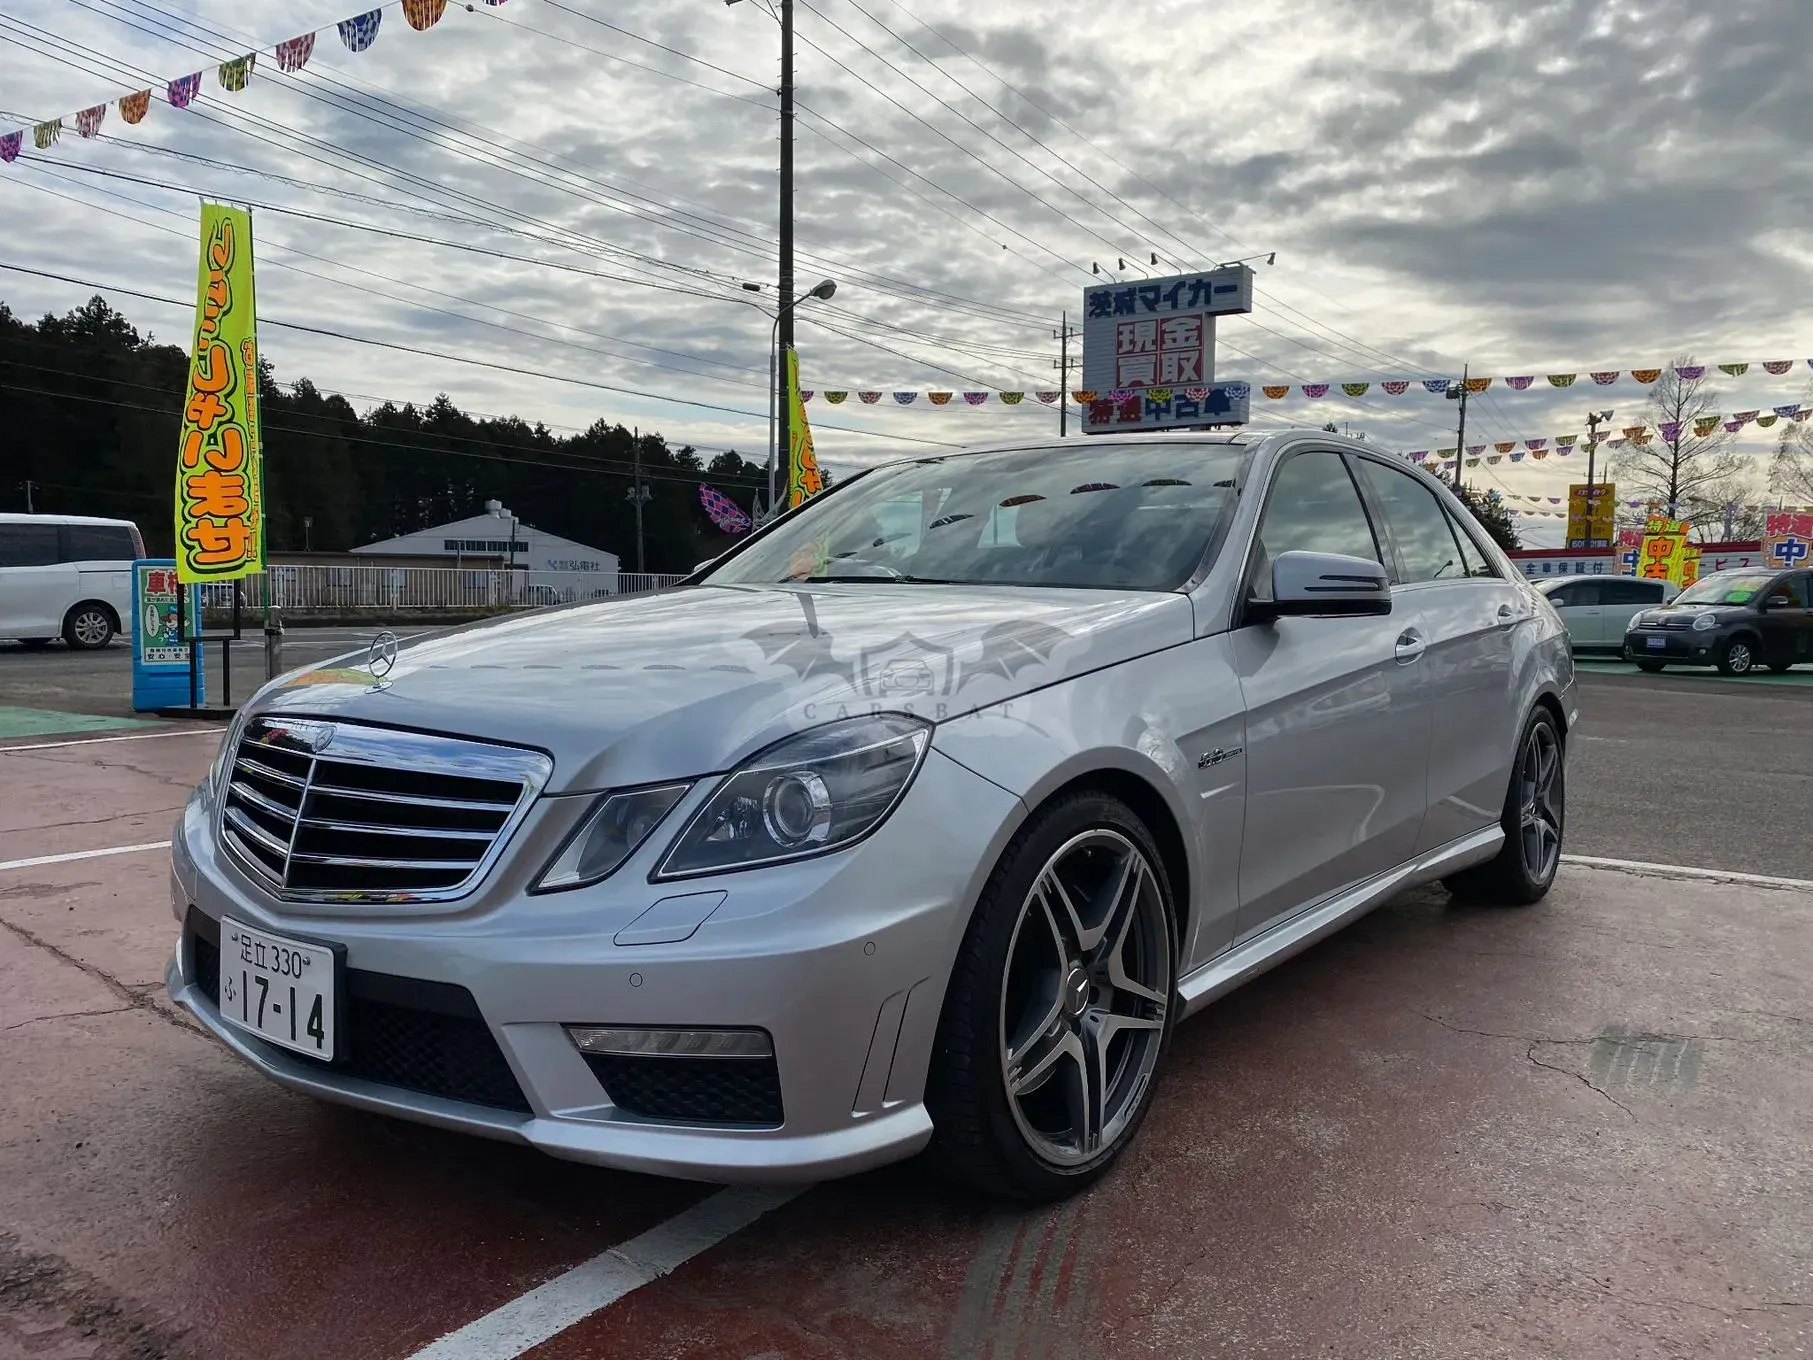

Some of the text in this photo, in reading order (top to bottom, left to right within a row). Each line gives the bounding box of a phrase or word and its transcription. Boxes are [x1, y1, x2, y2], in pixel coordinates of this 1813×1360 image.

[1088, 278, 1238, 318] 茨城マイカー
[1118, 317, 1201, 354] 現金
[1118, 352, 1200, 388] 買取
[1088, 388, 1232, 424] 特選中古車
[241, 934, 302, 979] 足立 330
[224, 976, 236, 1002] ふ
[243, 970, 325, 1050] 17-14
